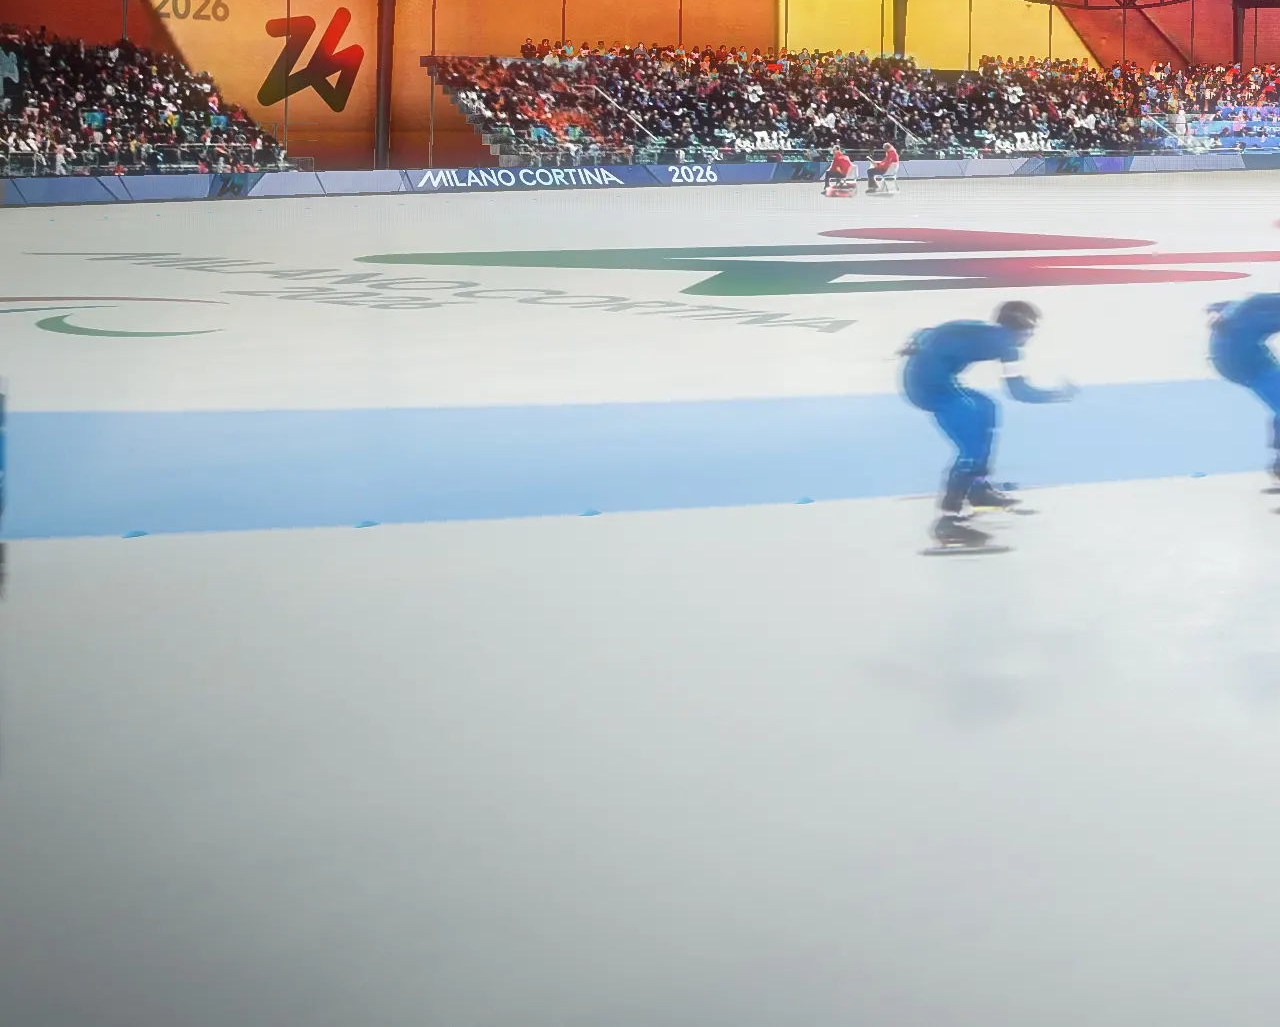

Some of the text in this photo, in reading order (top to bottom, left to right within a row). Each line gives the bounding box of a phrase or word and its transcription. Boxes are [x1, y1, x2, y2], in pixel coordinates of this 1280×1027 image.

[417, 165, 718, 188] MILANO CORTINA 2026
[22, 252, 859, 334] MILANO CORTINA
